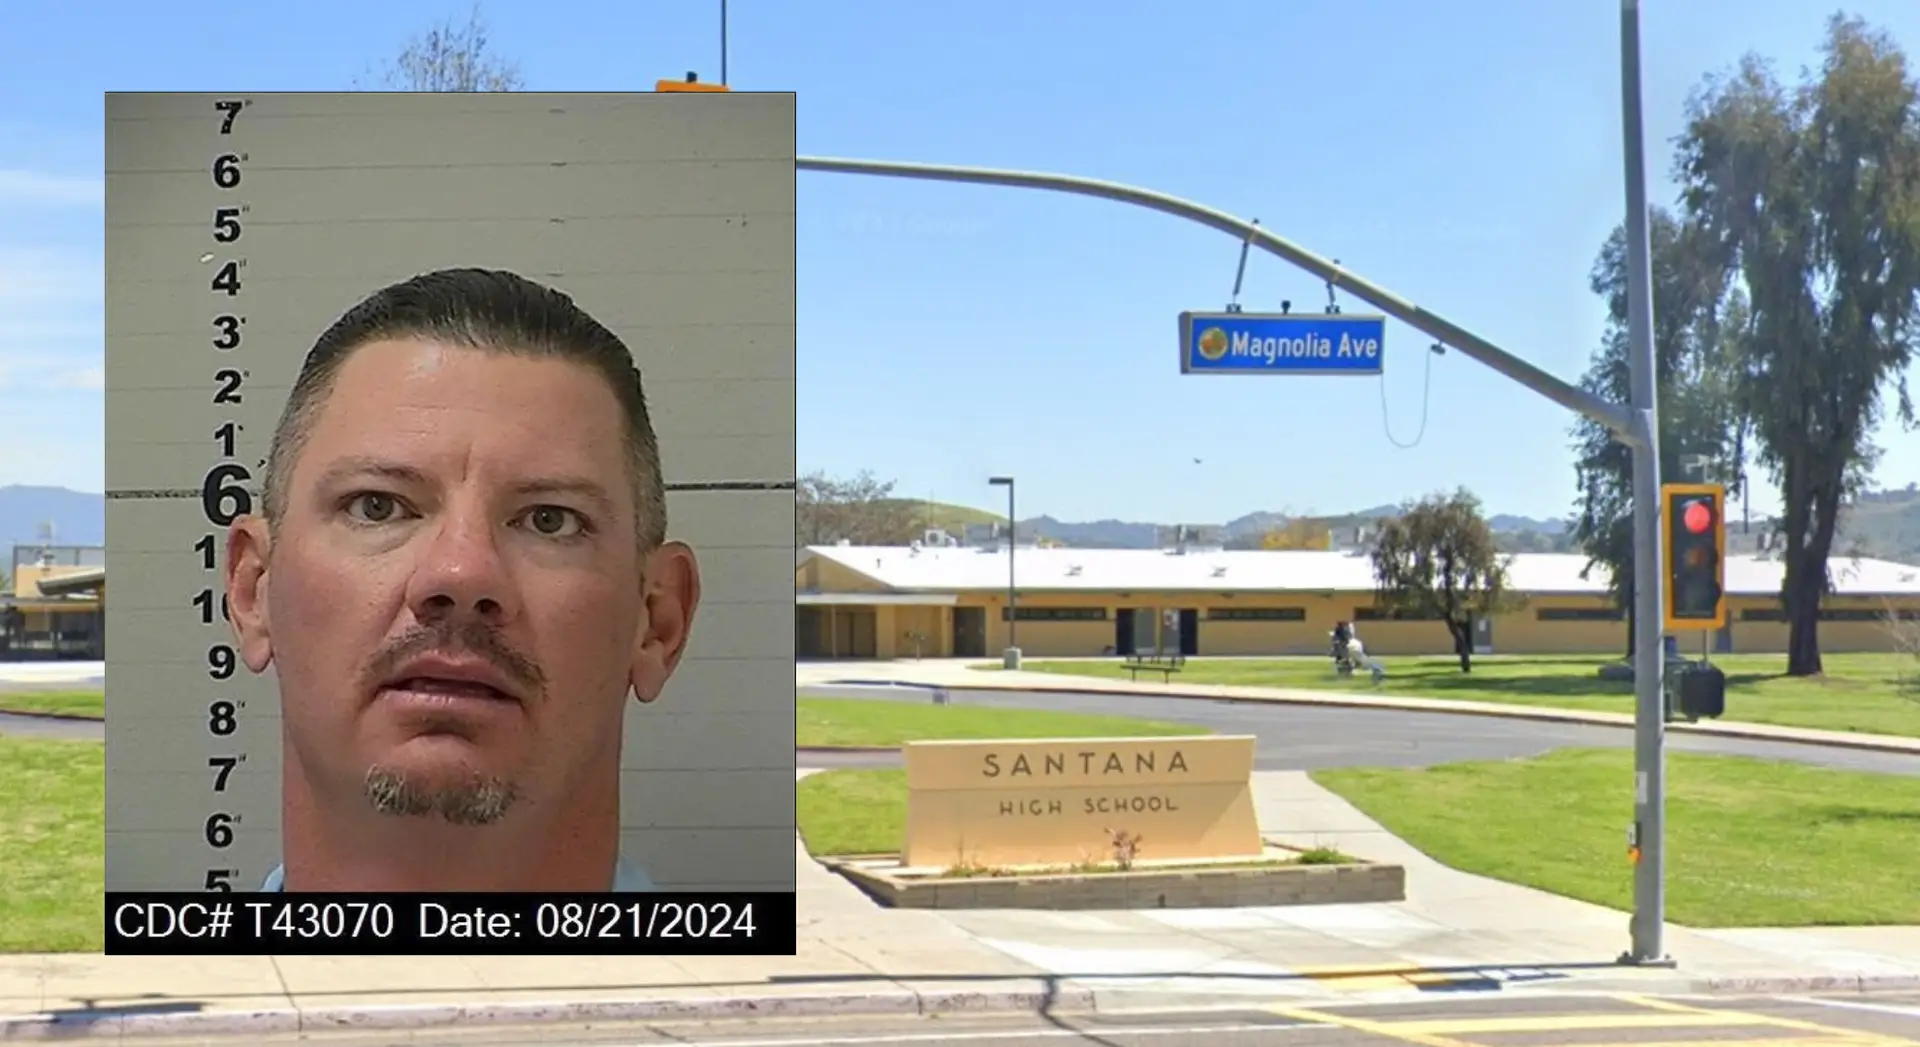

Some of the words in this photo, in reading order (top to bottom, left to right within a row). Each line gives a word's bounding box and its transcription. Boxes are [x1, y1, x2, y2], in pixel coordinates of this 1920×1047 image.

[1231, 331, 1331, 365] Magnolia
[1337, 332, 1378, 358] Ave
[192, 589, 230, 623] 1
[982, 751, 1189, 777] SANTANA
[999, 799, 1062, 816] HIGH
[1084, 796, 1179, 814] SCHOOL
